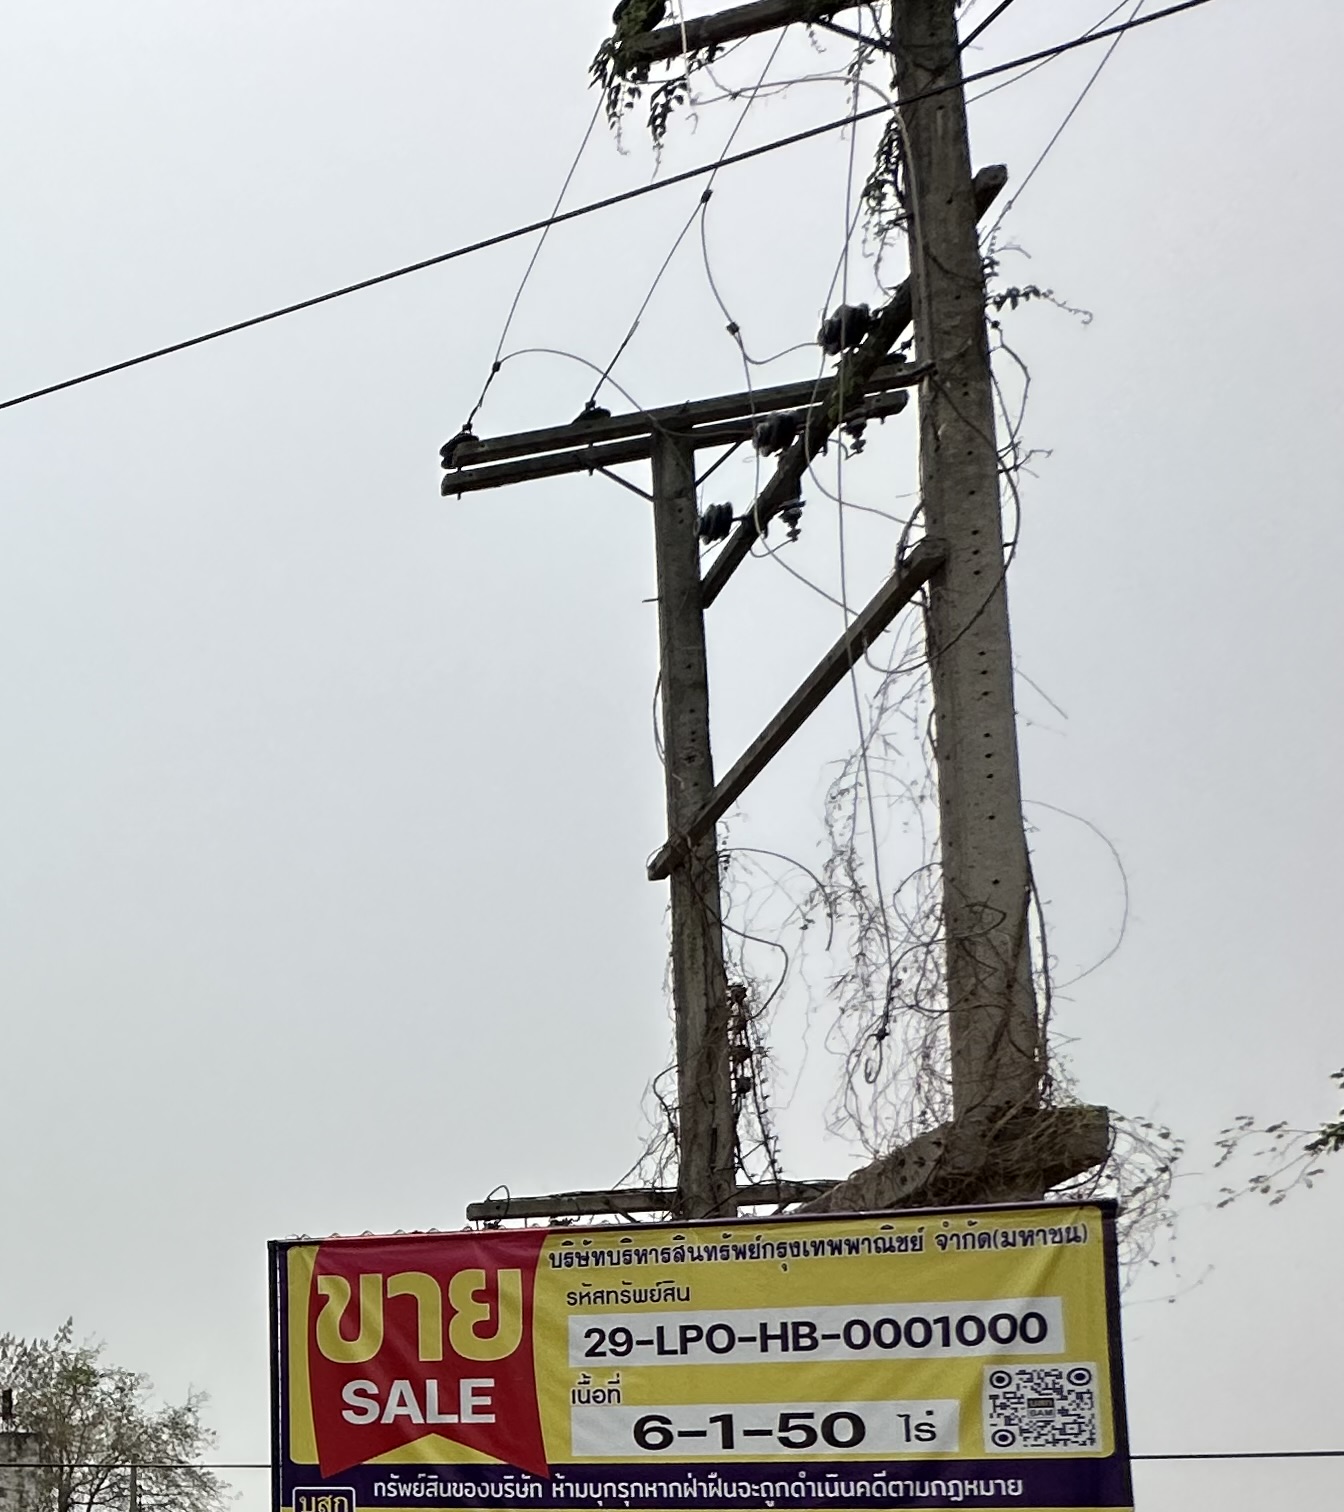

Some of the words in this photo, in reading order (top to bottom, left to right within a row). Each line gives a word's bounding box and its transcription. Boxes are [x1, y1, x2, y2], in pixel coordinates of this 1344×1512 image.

[549, 1225, 925, 1272] บริษัทบริหารสินทรัพย์กรุงเทพพาณิชย์
[934, 1220, 1088, 1251] จำกัด(มหาชน)
[566, 1280, 691, 1306] รหัสทรัพย์สิน
[316, 1268, 523, 1364] ขาย
[583, 1311, 1048, 1358] 29-LPO-HB-0001000
[341, 1378, 496, 1425] SALE
[571, 1373, 621, 1405] เนื้อที่
[633, 1411, 866, 1451] 6-1-50
[896, 1410, 937, 1442] ไร่
[373, 1473, 543, 1498] ทรัพย์สินของบริษัท
[552, 1470, 1023, 1507] ห้ามบุกรุกหากฝ่าฝืนจะถูกดำเนินคดีตามกฎหมาย
